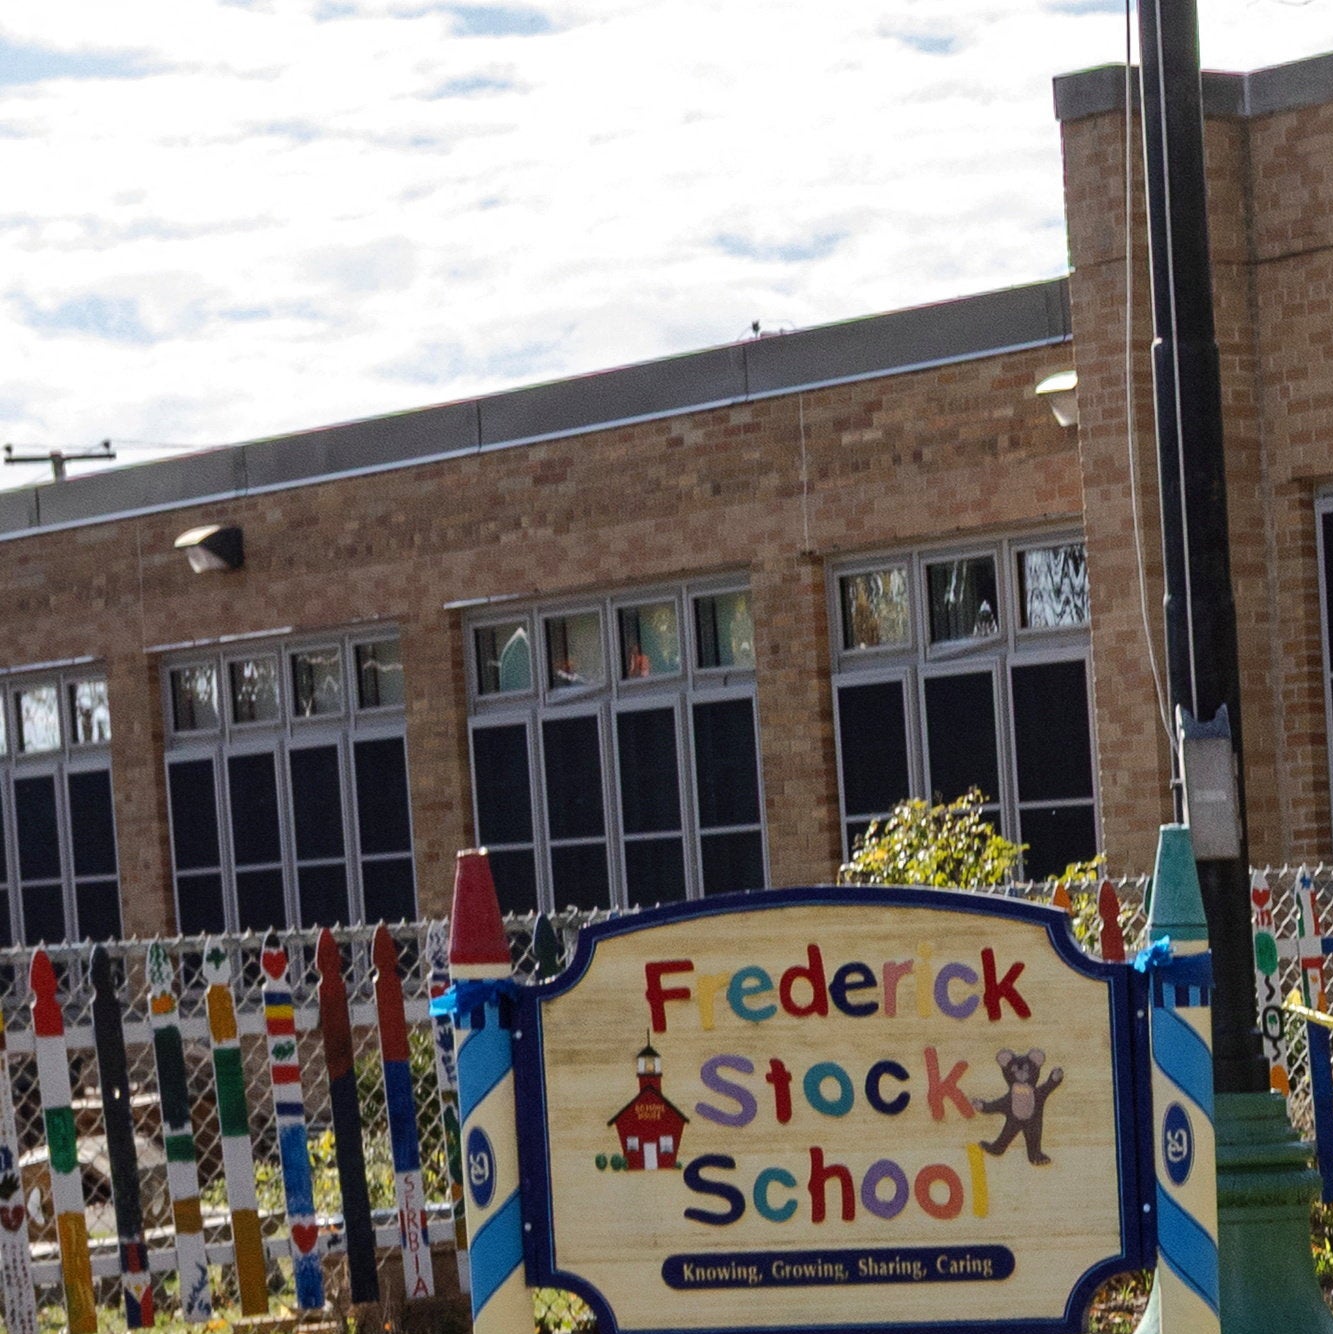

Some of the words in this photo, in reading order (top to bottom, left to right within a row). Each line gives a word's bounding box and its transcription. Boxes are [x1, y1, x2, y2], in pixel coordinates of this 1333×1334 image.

[645, 942, 1032, 1033] Frederick
[694, 1046, 975, 1128] Stock
[683, 1143, 989, 1226] School
[683, 1262, 763, 1285] Knowing,
[771, 1260, 849, 1280] Growing,
[858, 1257, 927, 1279] Sharing,
[936, 1254, 993, 1277] Caring
